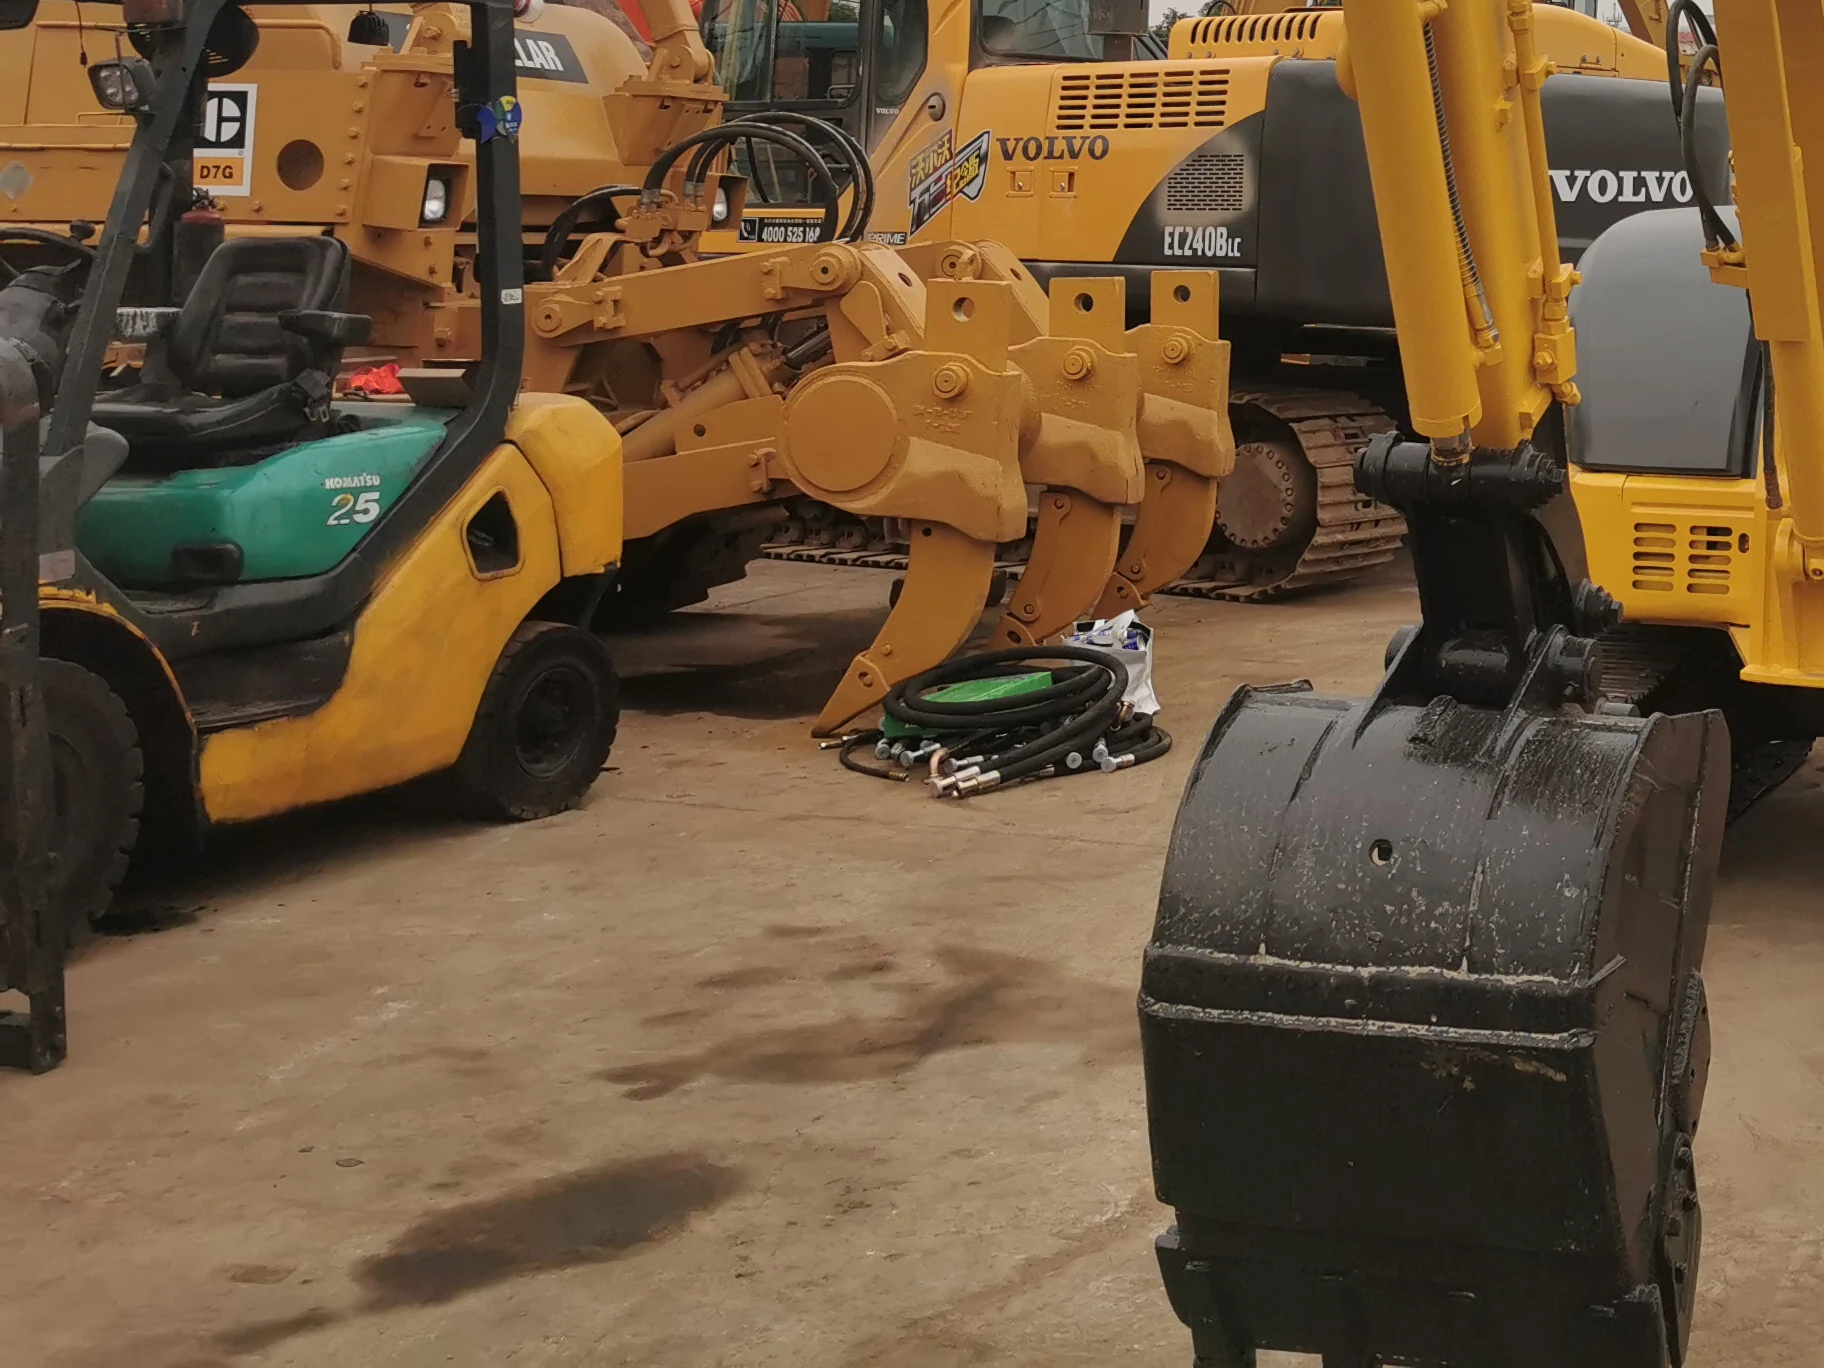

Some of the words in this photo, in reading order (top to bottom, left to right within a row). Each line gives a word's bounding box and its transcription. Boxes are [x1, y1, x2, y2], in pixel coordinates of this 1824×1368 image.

[876, 107, 899, 115] VOLVO
[996, 135, 1110, 161] VOLVO
[200, 165, 234, 179] D7G
[1548, 169, 1694, 203] VOLVO
[762, 226, 785, 243] 4000
[786, 226, 804, 243] 525
[325, 472, 381, 489] KOMATSU
[326, 492, 381, 525] 25
